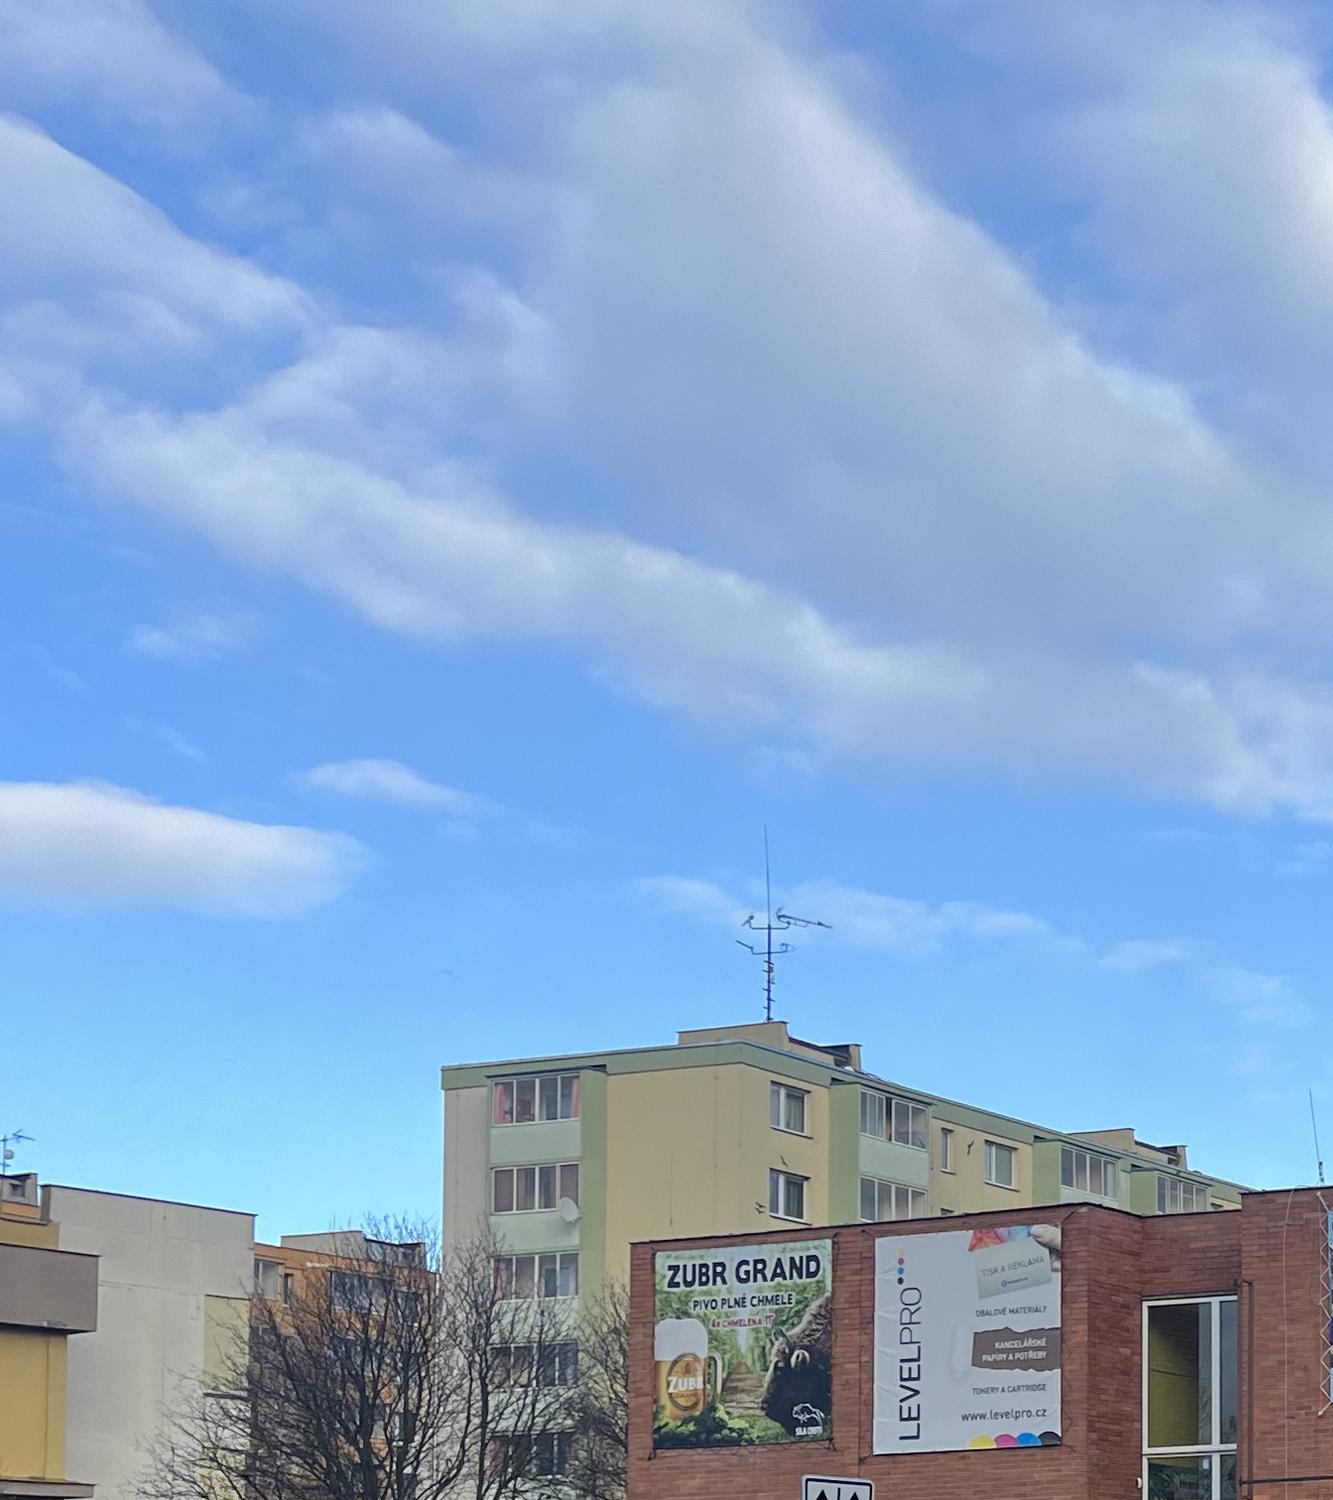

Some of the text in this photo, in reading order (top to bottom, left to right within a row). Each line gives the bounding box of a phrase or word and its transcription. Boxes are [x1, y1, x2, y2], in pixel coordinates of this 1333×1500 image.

[667, 1254, 821, 1289] ZUBR GRAND
[982, 1256, 1045, 1277] TISK A REKLAMA
[693, 1293, 793, 1311] PIVO PLNÉ CHMELE
[975, 1304, 1047, 1317] OBALOVÉ MATERIÁLY
[995, 1337, 1047, 1349] KANCELÁŘSKÉ
[899, 1287, 922, 1440] LEVELPRO
[982, 1350, 1047, 1362] PAPÍRY A POTŘEBY
[972, 1387, 1000, 1395] TONERY
[1007, 1384, 1047, 1393] CARTRIDGE
[961, 1407, 1047, 1422] www.levelpro.cz
